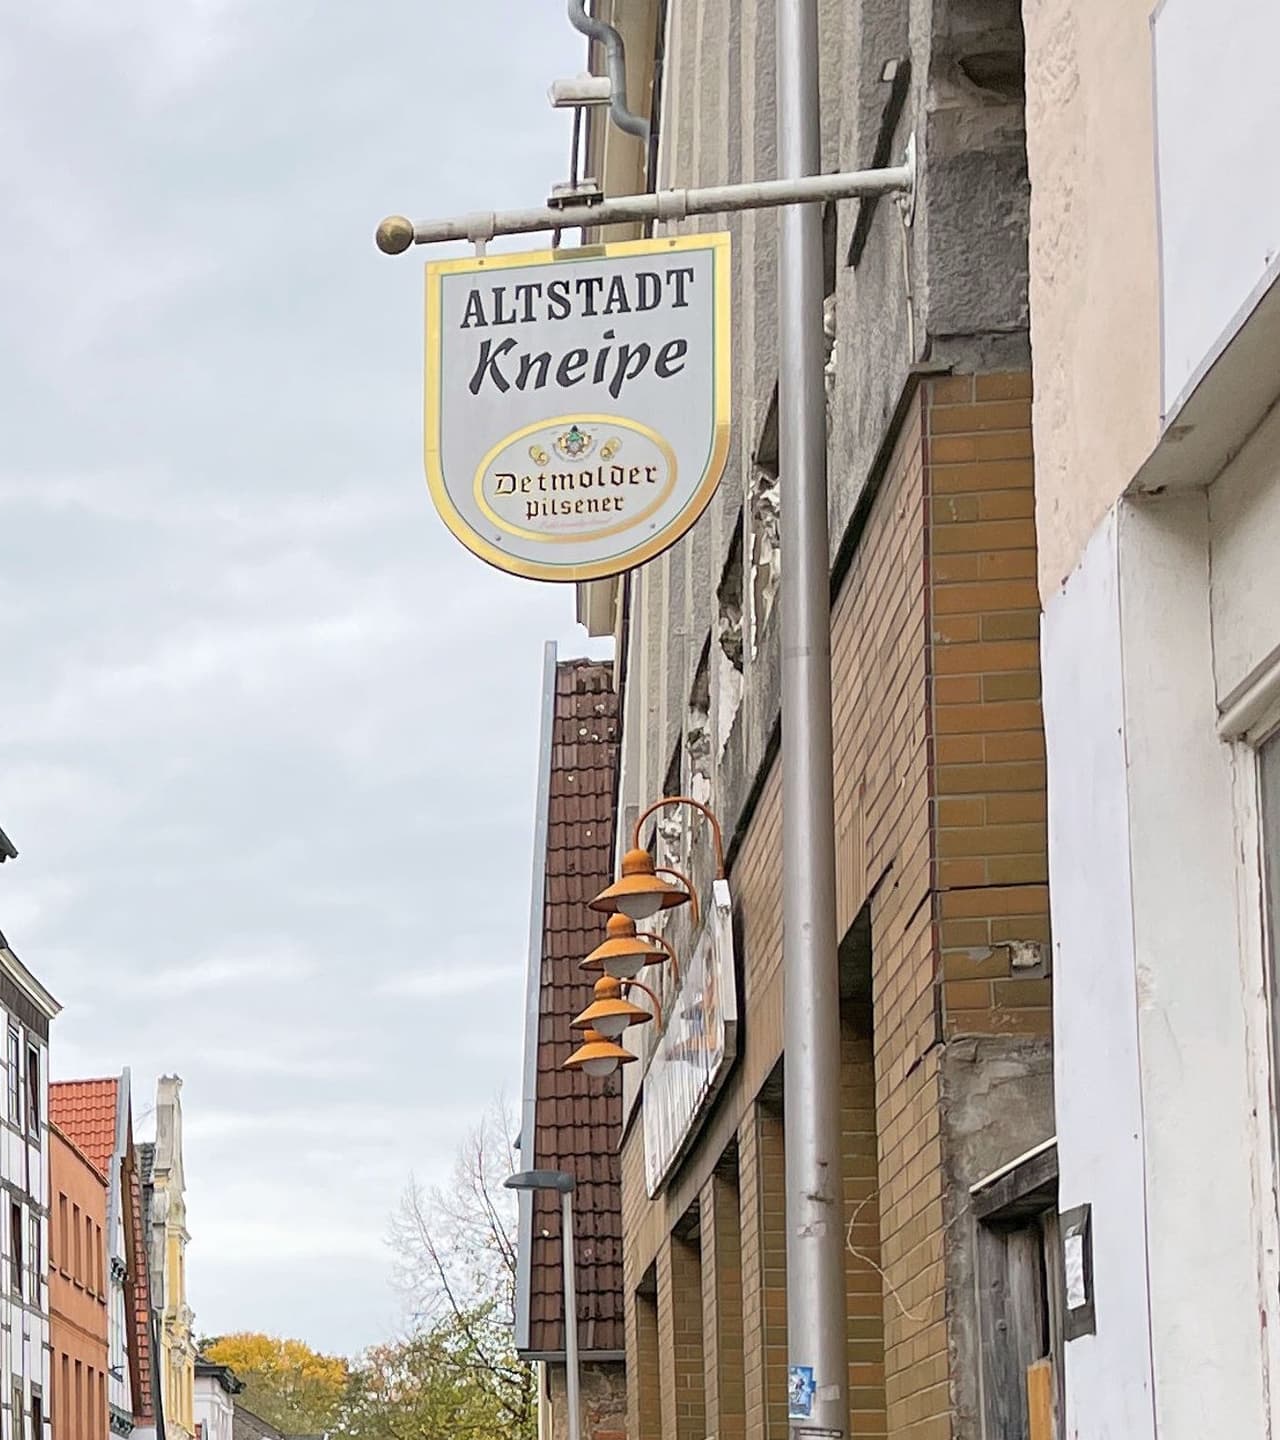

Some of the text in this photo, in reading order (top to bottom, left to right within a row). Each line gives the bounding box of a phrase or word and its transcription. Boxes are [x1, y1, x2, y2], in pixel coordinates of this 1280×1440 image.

[460, 269, 694, 329] ALTSTADT
[468, 328, 688, 400] Kneipe
[494, 465, 657, 495] Detmolder
